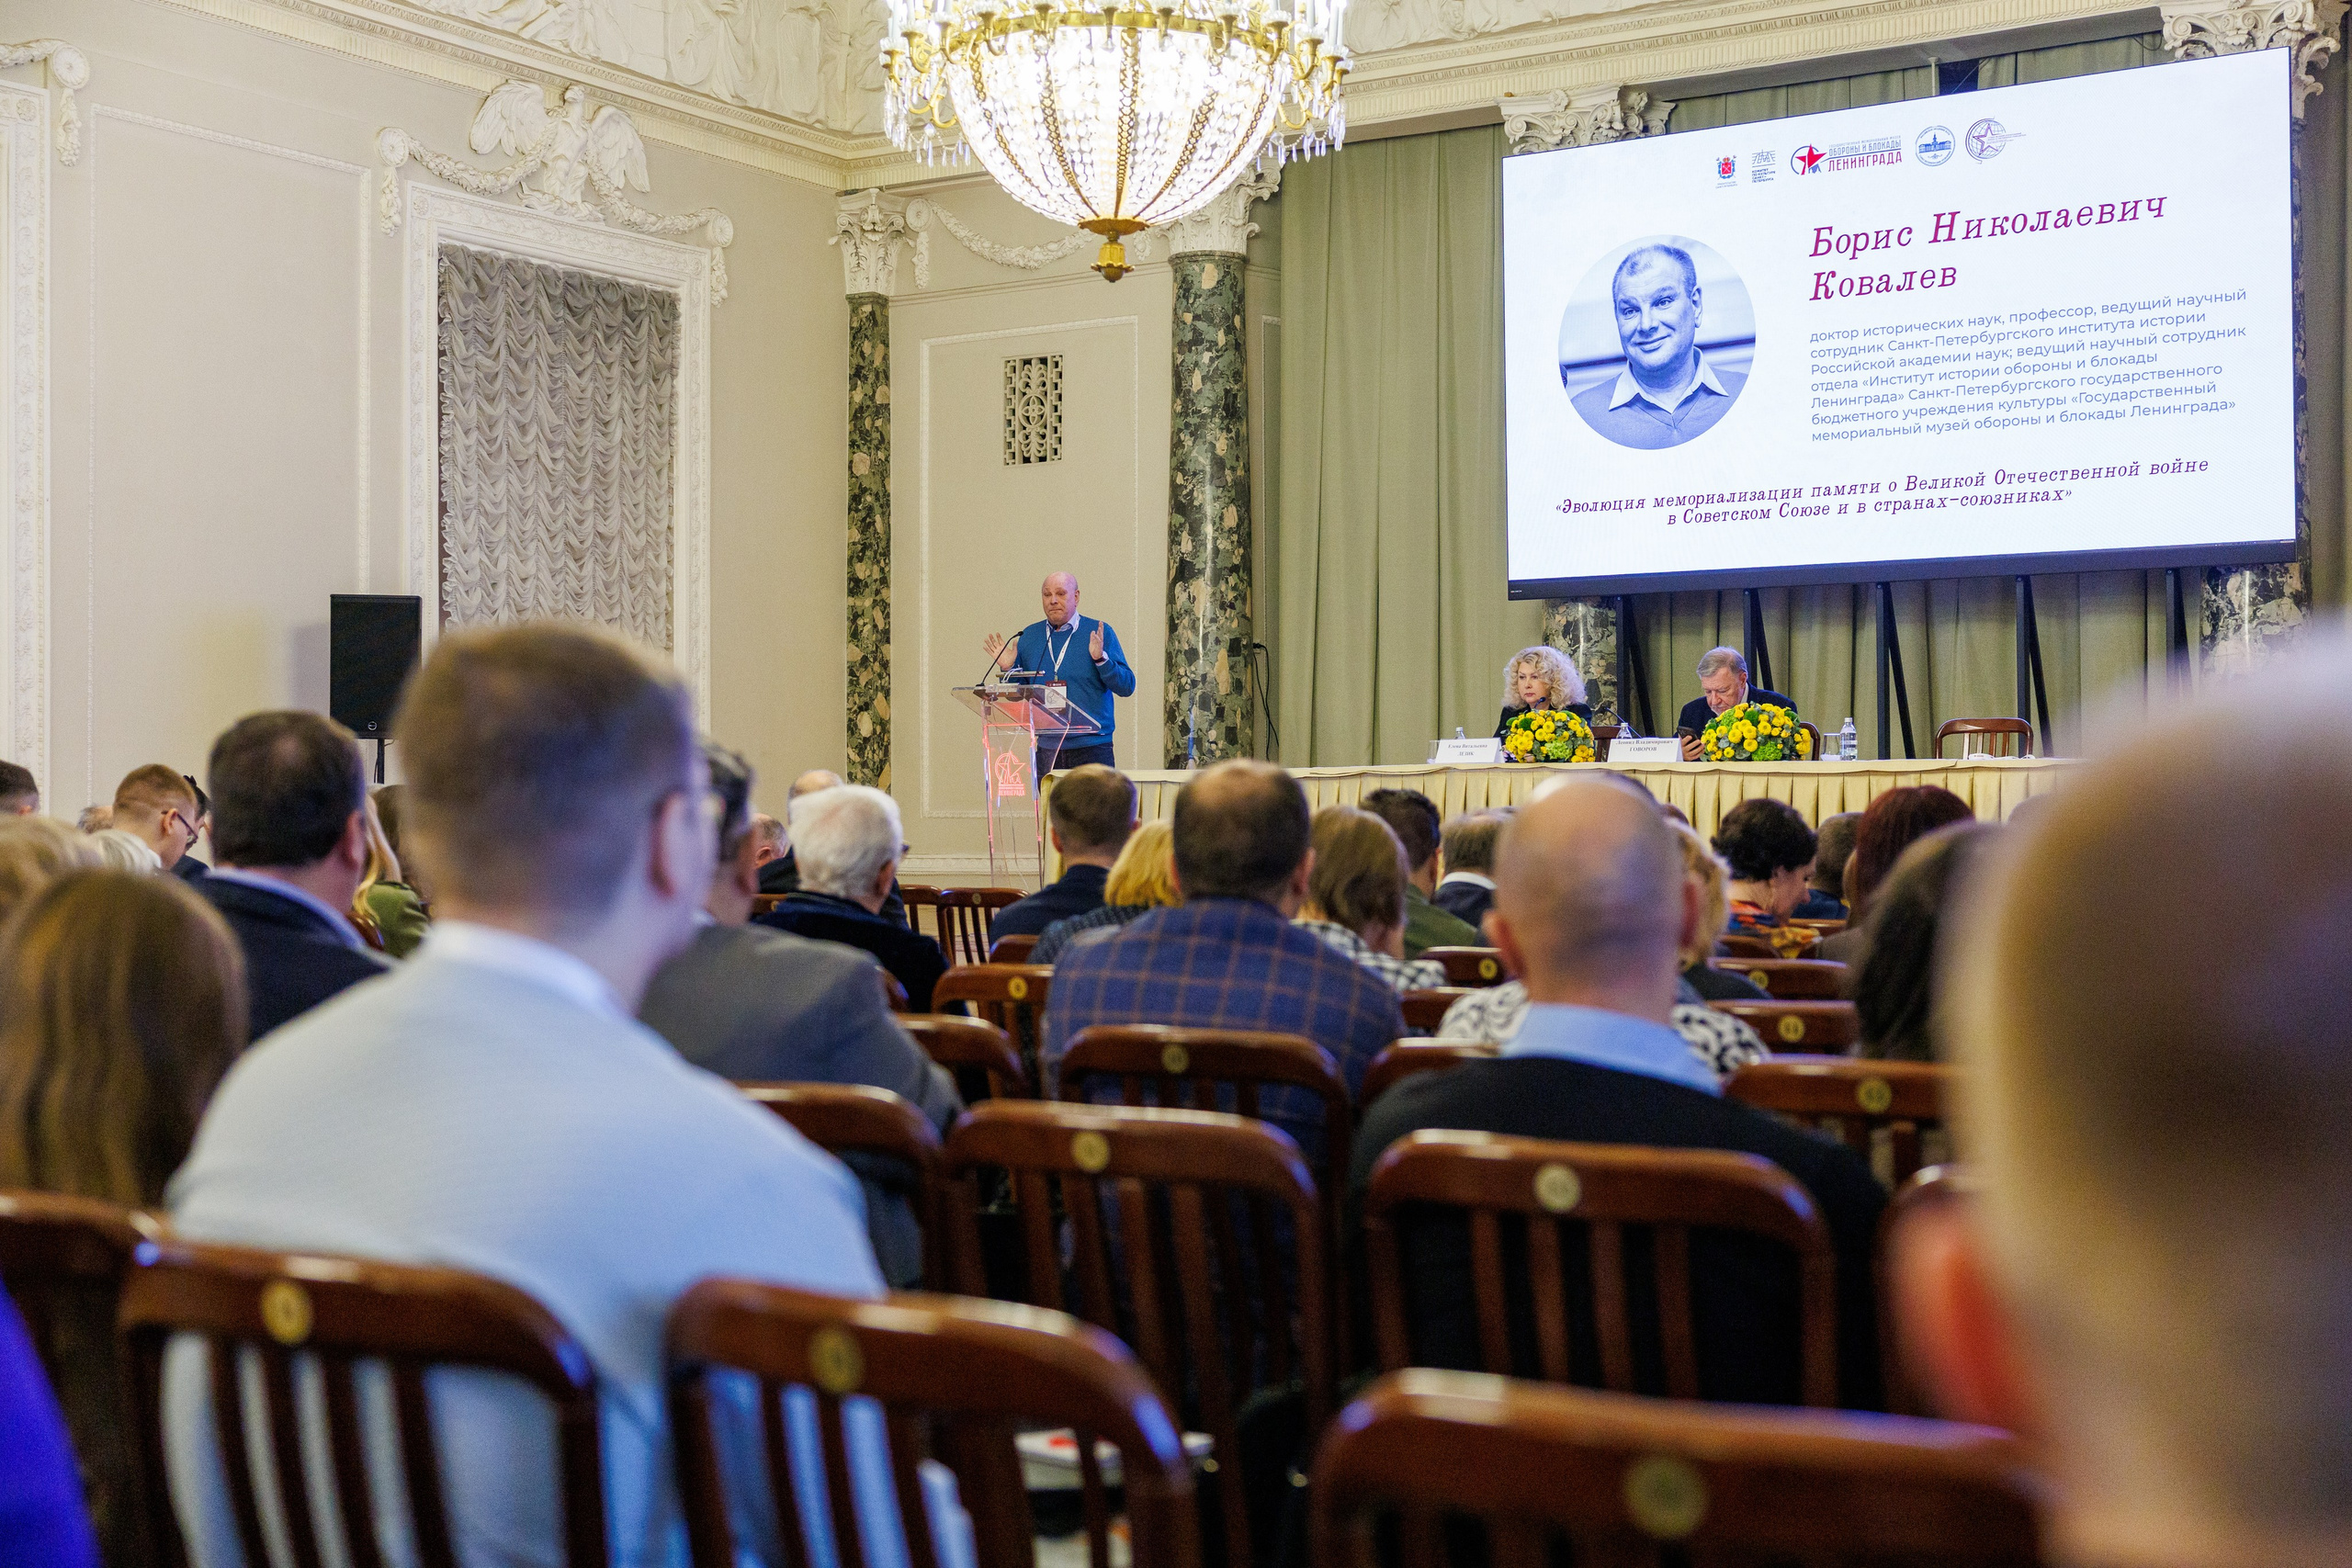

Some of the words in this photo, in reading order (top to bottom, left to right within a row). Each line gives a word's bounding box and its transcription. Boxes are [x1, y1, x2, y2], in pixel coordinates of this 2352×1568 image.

[1828, 152, 1902, 172] ЛЕНИНГРАДА
[1829, 145, 1860, 156] ОБОРОНЫ
[1869, 140, 1901, 151] БЛОКАДЫ
[1809, 225, 1913, 260] Борис
[1928, 196, 2167, 244] Николаевич
[1809, 266, 1958, 301] Ковалев
[1810, 329, 1859, 344] доктор
[1863, 319, 1964, 337] исторических
[1968, 314, 2005, 327] наук,
[2009, 307, 2097, 325] профессор,
[2102, 295, 2171, 314] ведущий
[2177, 288, 2246, 307] научный
[1810, 343, 1884, 359] сотрудник
[1888, 328, 2054, 352] Санкт-Петербургского
[2059, 319, 2135, 336] института
[2140, 312, 2206, 328] истории
[1811, 357, 1895, 375] Российской
[1899, 353, 1971, 368] академии
[1975, 347, 2013, 360] наук;
[2017, 340, 2085, 357] ведущий
[2090, 333, 2157, 351] научный
[2162, 327, 2246, 344] сотрудник
[1811, 378, 1858, 392] отдела
[1862, 372, 1934, 388] «Институт
[1939, 366, 2000, 381] истории
[2004, 361, 2071, 375] обороны
[2077, 359, 2086, 368] и
[2090, 352, 2157, 368] блокады
[1811, 392, 1904, 409] Ленинграда»
[1908, 377, 2076, 400] Санкт-Петербургского
[2080, 364, 2222, 386] государственного
[1812, 409, 1899, 425] бюджетного
[1902, 401, 1993, 420] учреждения
[1998, 395, 2066, 412] культуры
[2071, 381, 2216, 404] «Государственный
[1812, 422, 1922, 442] мемориальный
[1926, 419, 1970, 435] музей
[1974, 413, 2041, 429] обороны
[2046, 413, 2055, 423] и
[2059, 407, 2126, 423] блокады
[2130, 399, 2235, 418] Ленинграда»
[1556, 497, 1645, 514] «Эволюция
[1653, 486, 1804, 508] мемориализации
[1811, 482, 1881, 498] памяти
[1888, 480, 1897, 492] о
[1904, 471, 1986, 492] Великой
[1994, 461, 2141, 485] Отечественной
[2149, 458, 2209, 476] войне
[1668, 513, 1676, 525] в
[1683, 506, 1771, 524] Советском
[1779, 502, 1830, 519] Союзе
[1838, 503, 1849, 515] и
[1856, 502, 1867, 514] в
